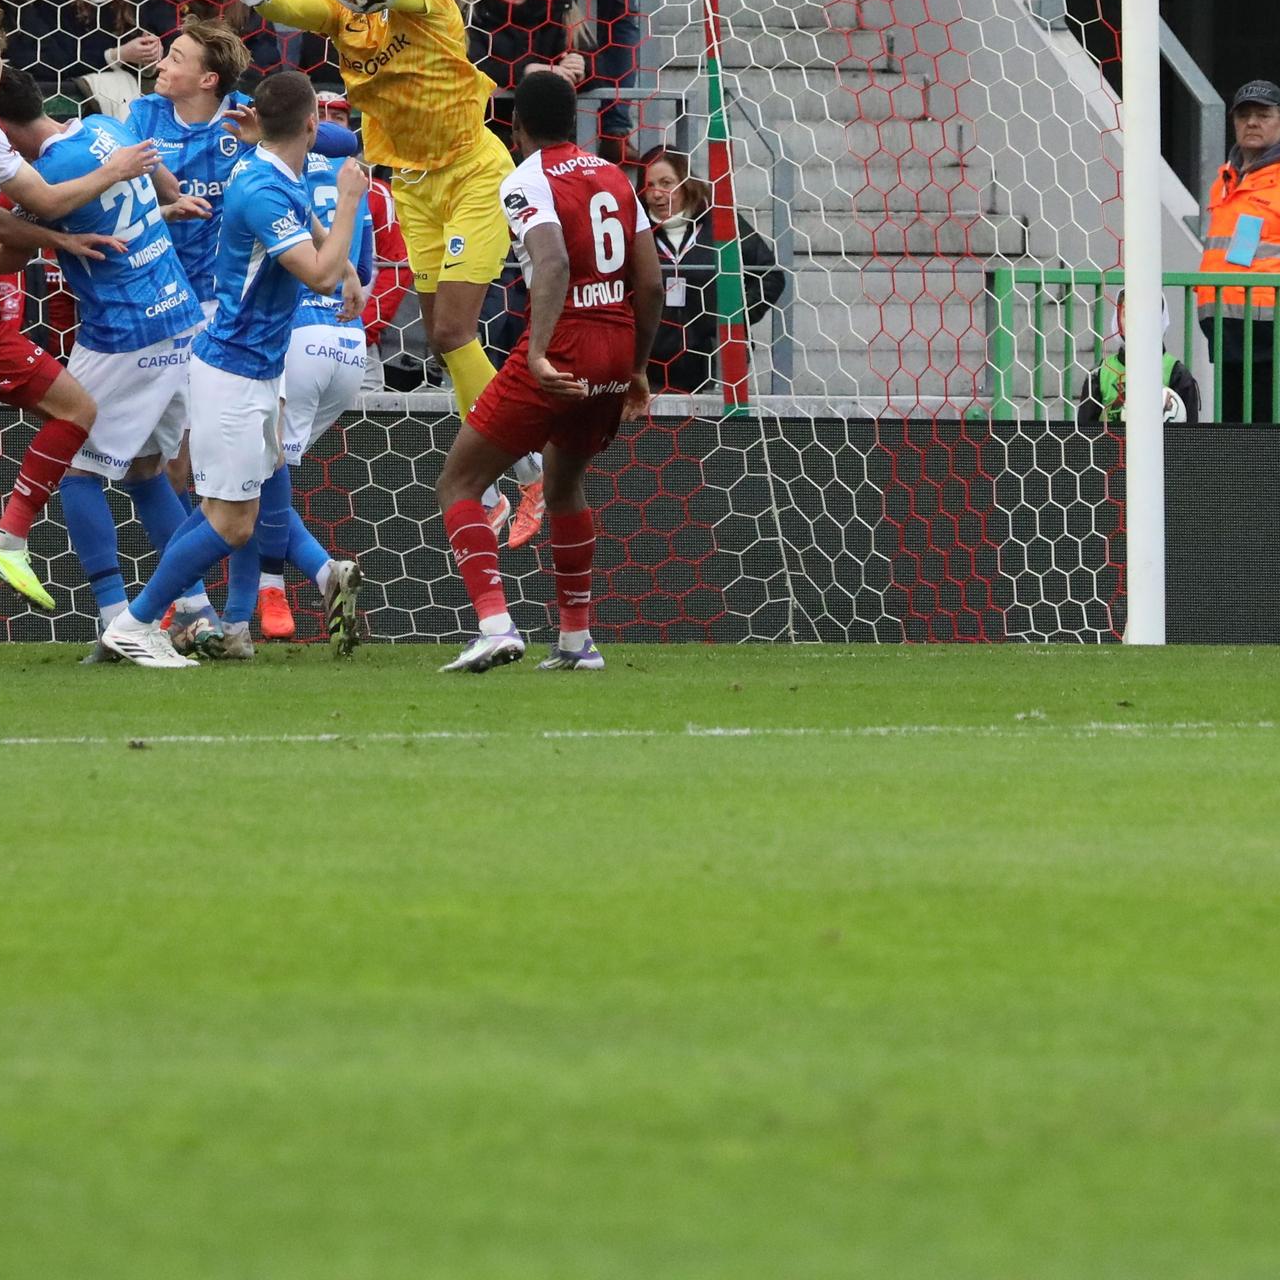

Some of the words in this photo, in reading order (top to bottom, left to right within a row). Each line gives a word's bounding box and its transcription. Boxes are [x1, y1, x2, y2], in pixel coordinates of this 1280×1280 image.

[545, 155, 611, 177] NAPOLEON
[589, 191, 626, 274] 6
[573, 280, 625, 308] LOFOLO
